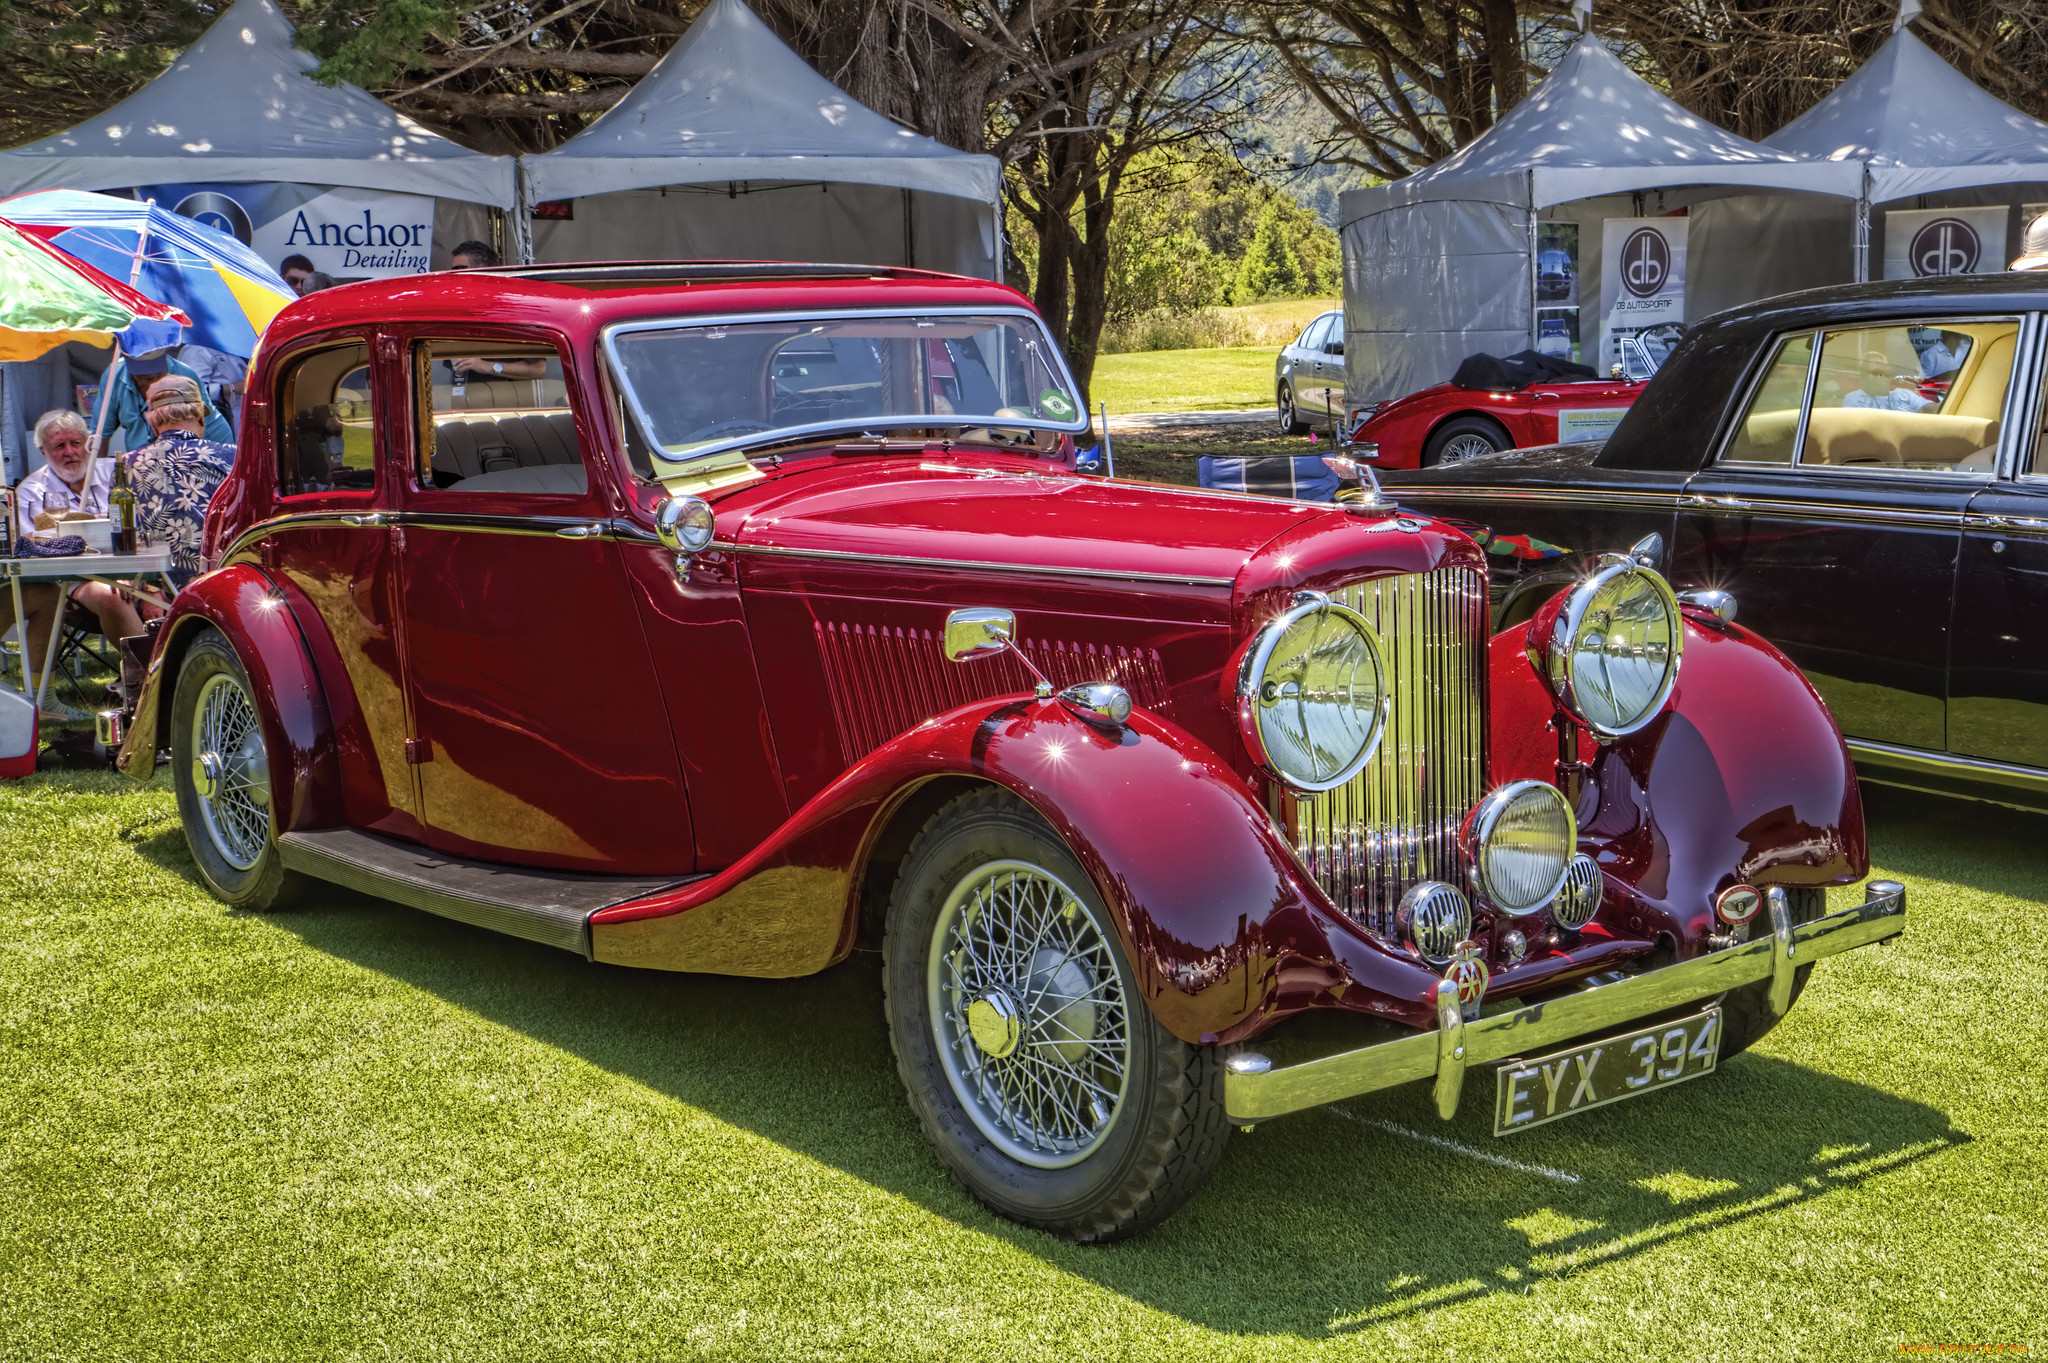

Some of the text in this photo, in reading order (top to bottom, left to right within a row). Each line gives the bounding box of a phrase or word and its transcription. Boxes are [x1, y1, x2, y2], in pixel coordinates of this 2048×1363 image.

[284, 209, 426, 246] Anchor
[342, 249, 427, 274] Detailing
[1505, 1017, 1717, 1127] EYX 394
